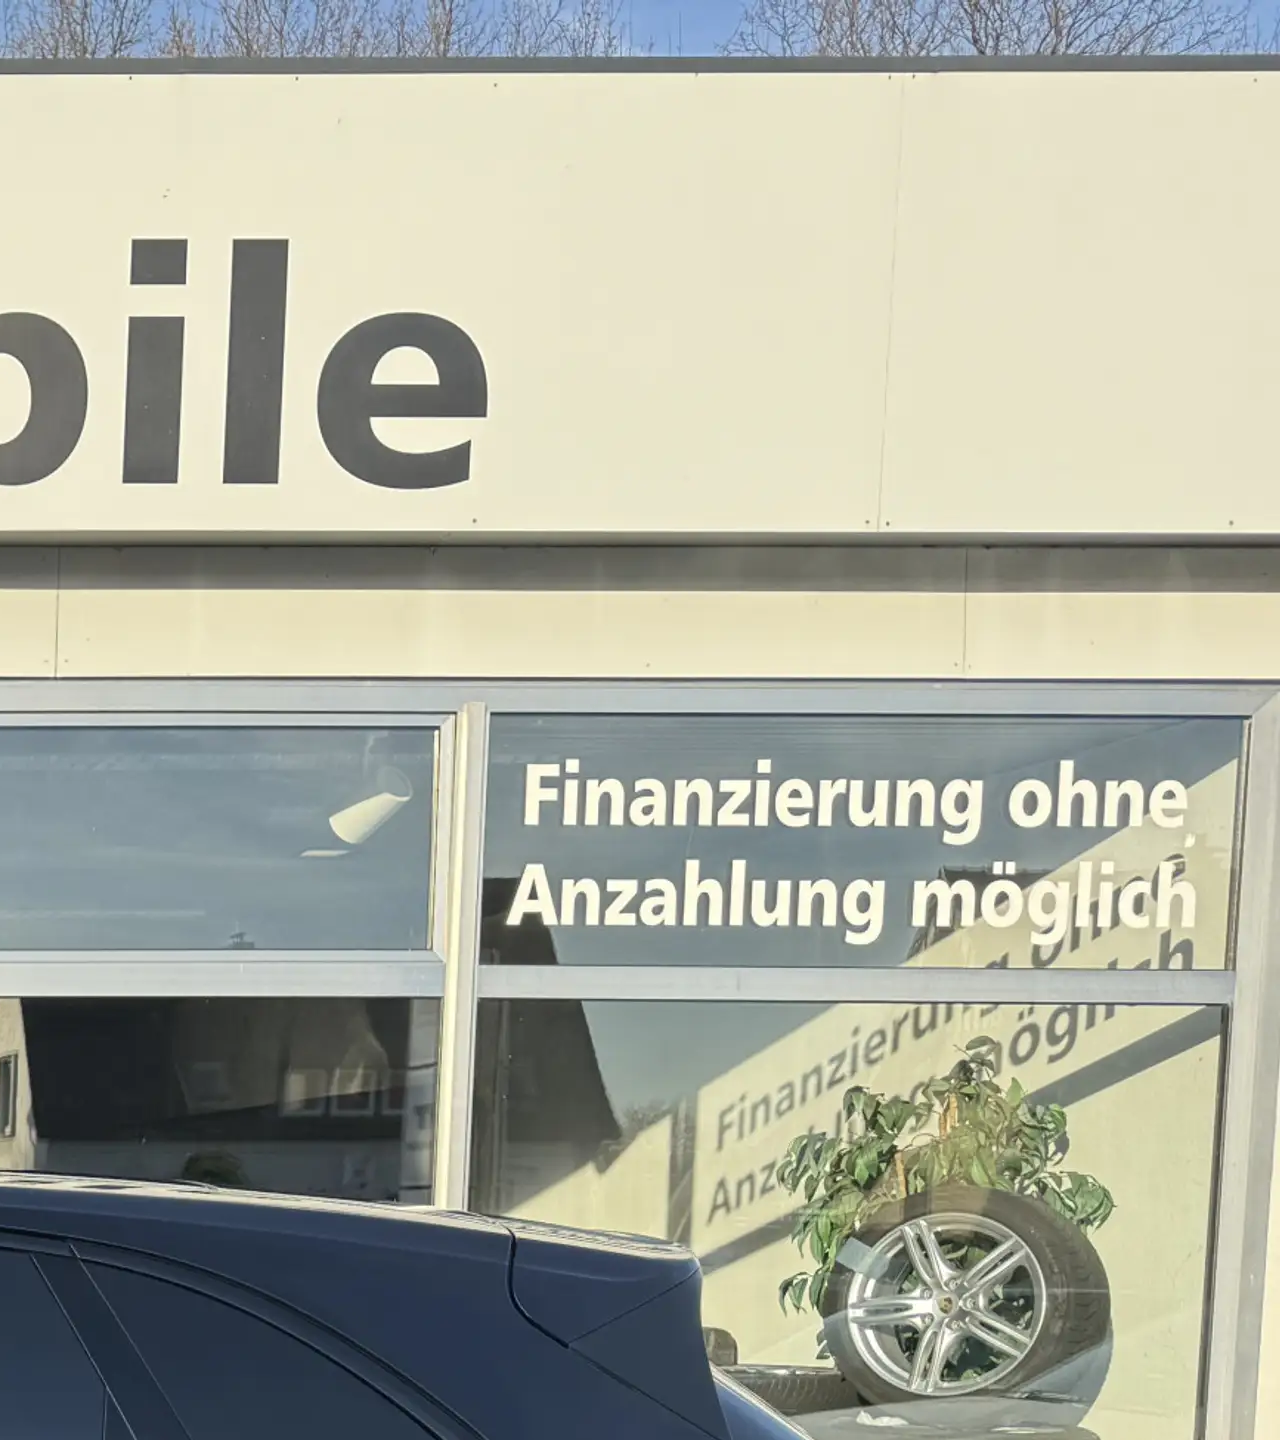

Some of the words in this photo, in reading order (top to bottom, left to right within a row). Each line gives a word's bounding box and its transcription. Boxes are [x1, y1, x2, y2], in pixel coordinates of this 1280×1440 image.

[523, 758, 983, 846] Finanzierung
[1008, 760, 1189, 829] ohne
[506, 858, 886, 946] Anzahlung
[911, 860, 1196, 946] möglich
